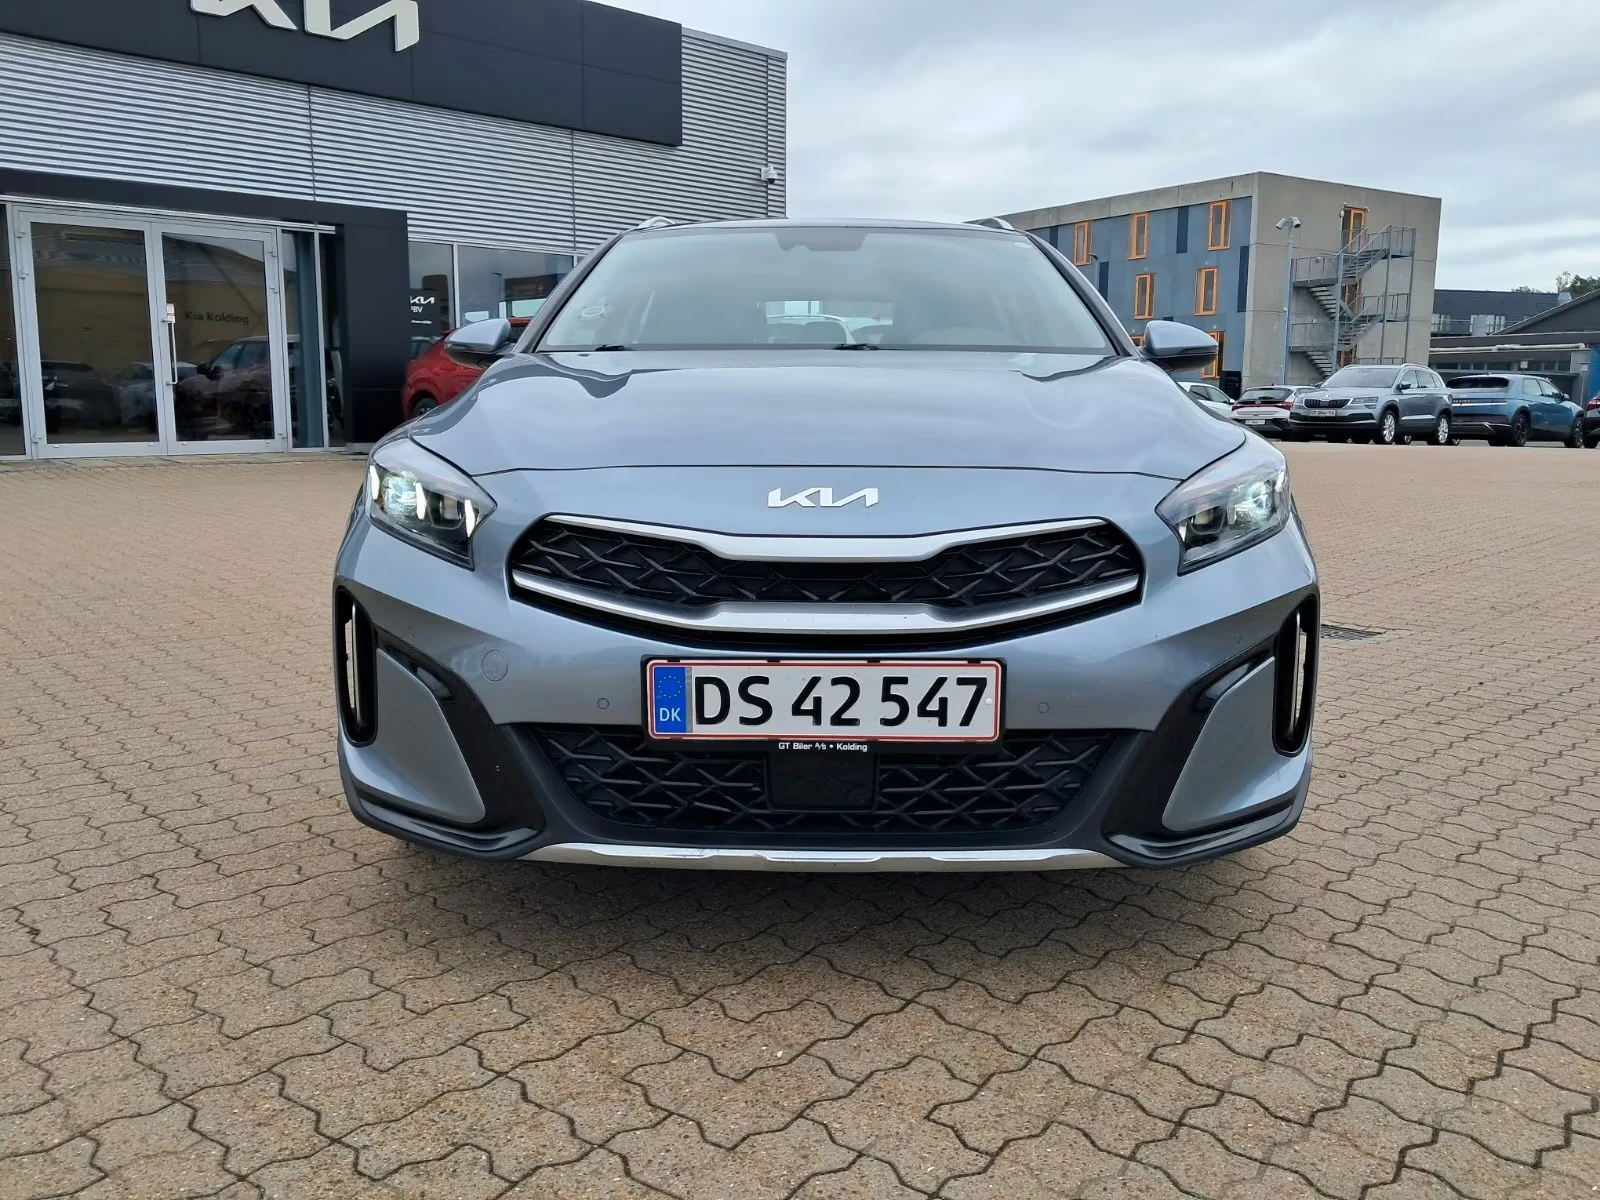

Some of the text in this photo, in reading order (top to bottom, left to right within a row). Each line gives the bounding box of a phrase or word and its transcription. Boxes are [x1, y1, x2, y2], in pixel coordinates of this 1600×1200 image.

[410, 296, 435, 304] KIA
[184, 311, 249, 325] Kia Kolding
[767, 487, 879, 508] KIA
[694, 675, 988, 728] DS 42 547
[659, 707, 682, 722] DK
[778, 742, 790, 750] GT
[792, 742, 813, 750] Biler
[836, 742, 868, 752] Kolding
